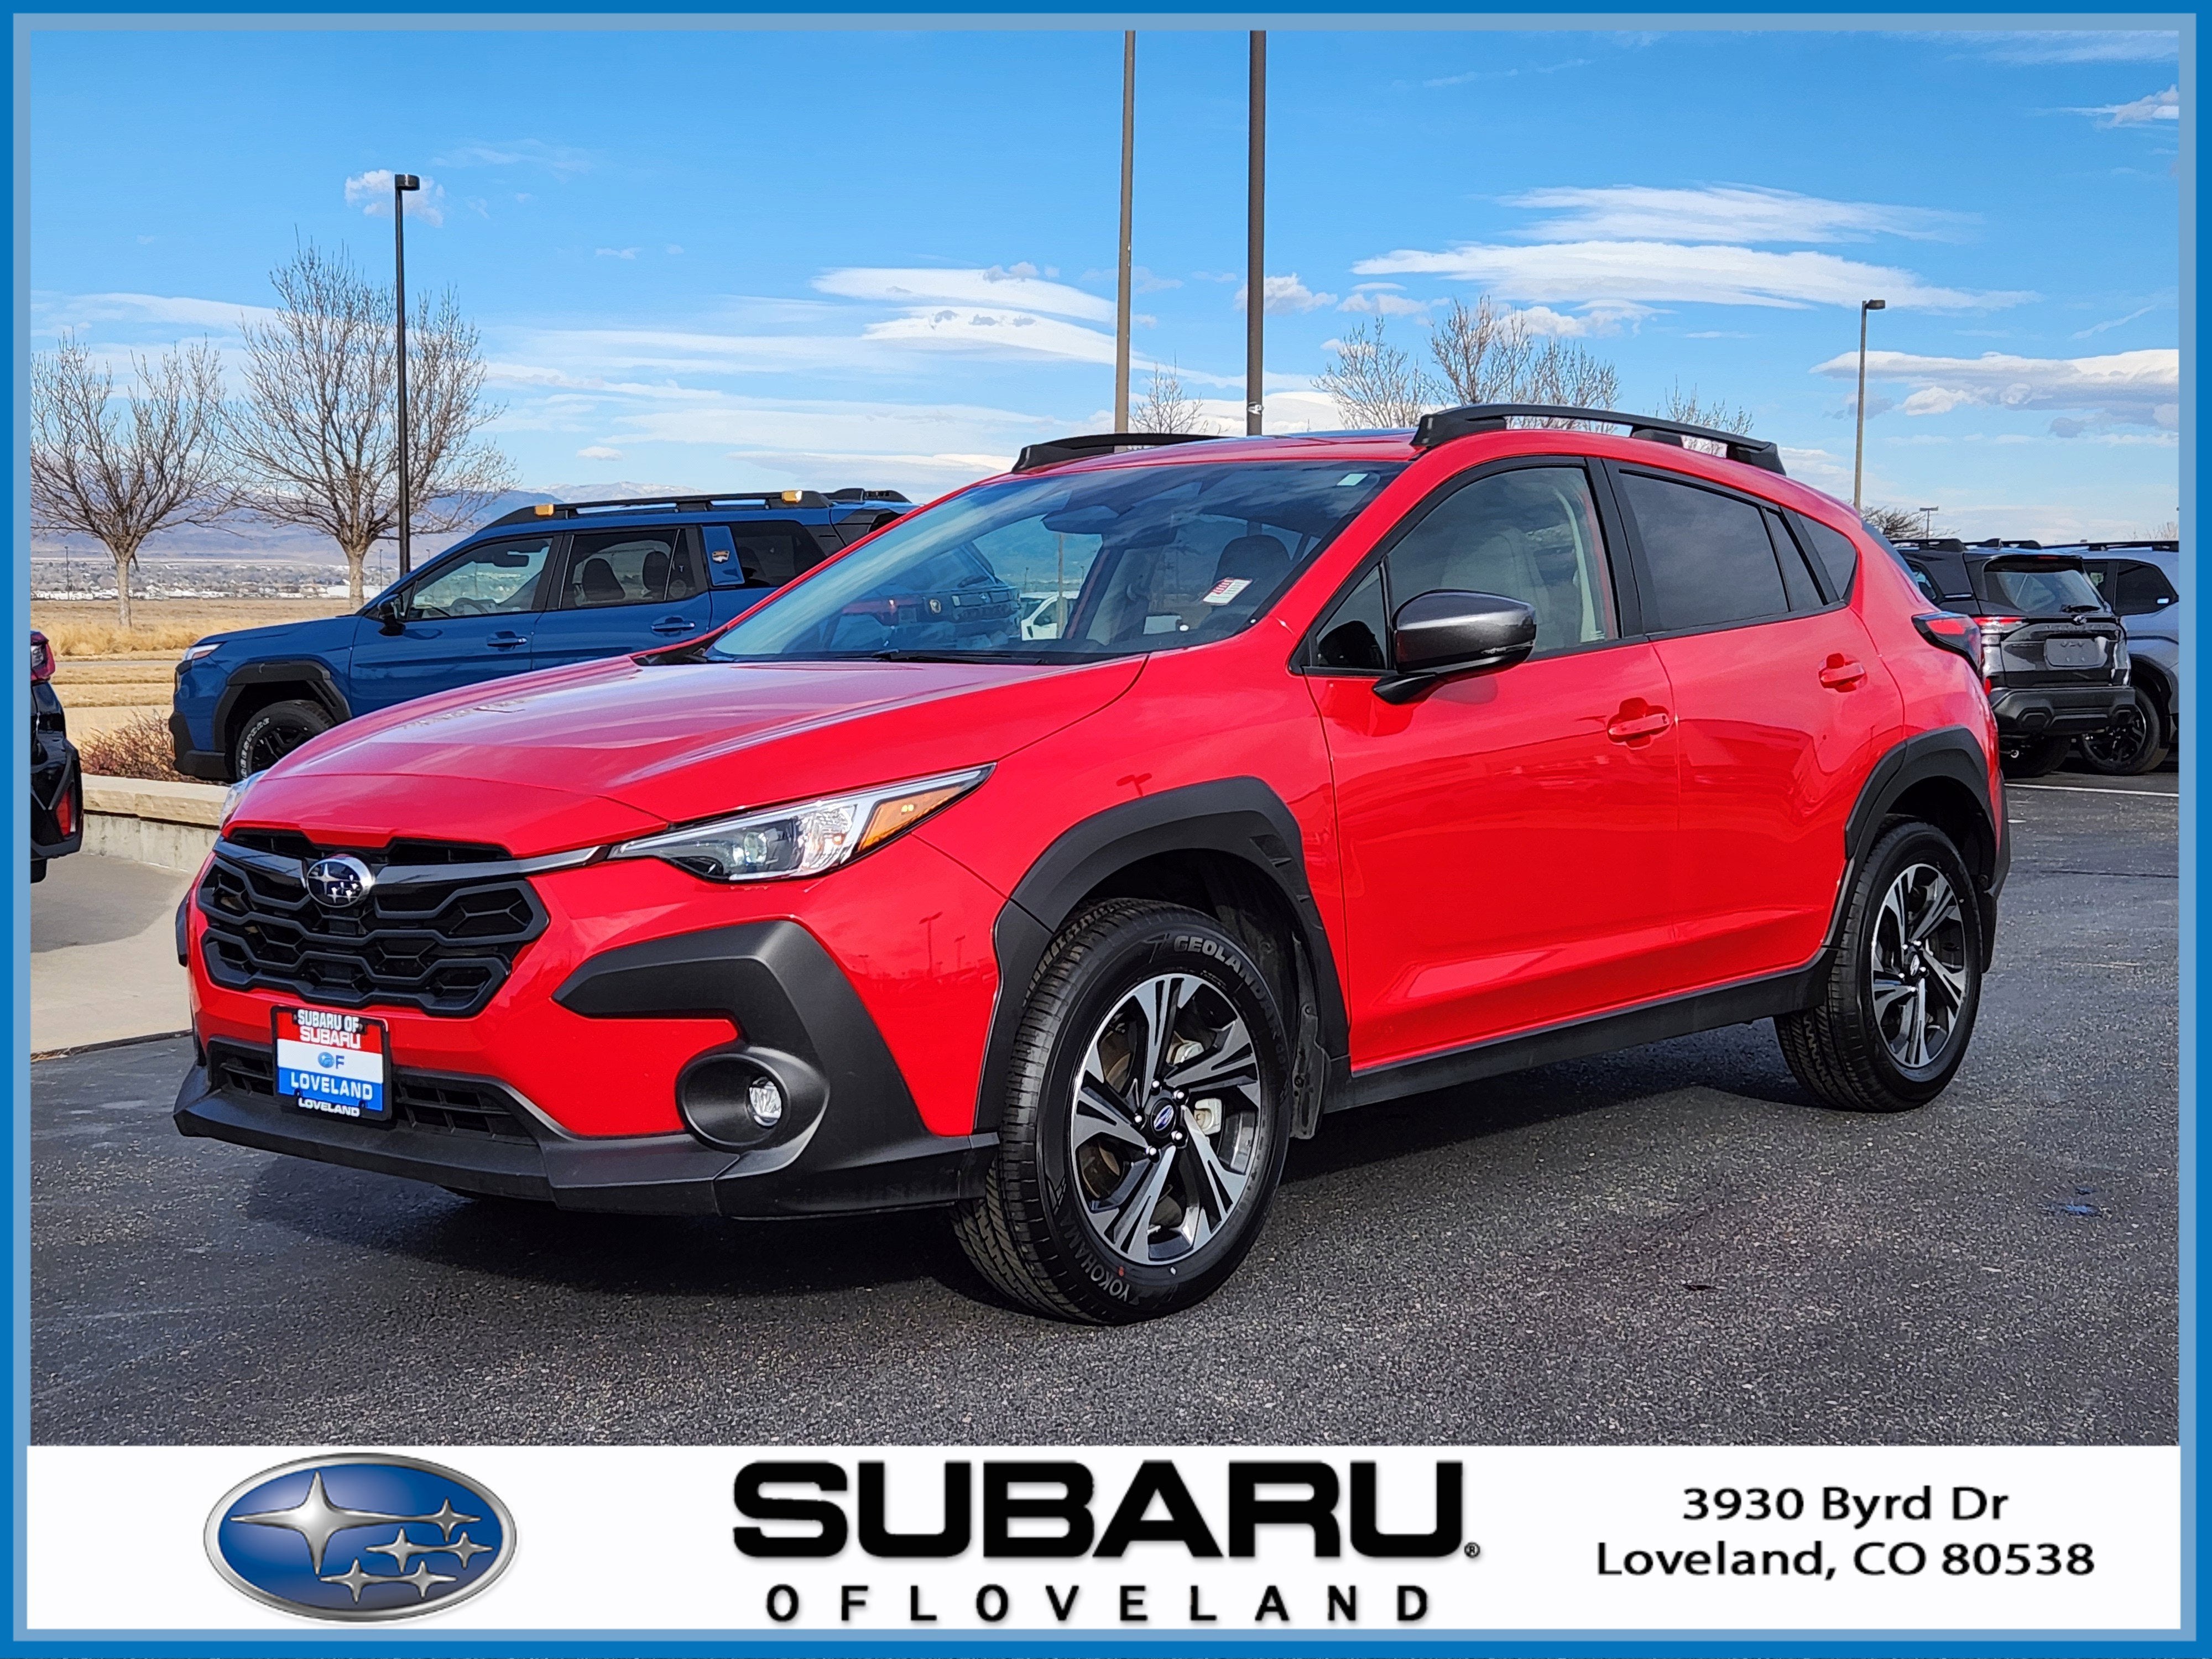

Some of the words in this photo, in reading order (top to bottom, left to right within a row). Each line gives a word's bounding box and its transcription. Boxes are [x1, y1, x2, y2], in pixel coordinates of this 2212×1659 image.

[298, 1009, 342, 1031] SUBARU
[343, 1015, 359, 1033] OF
[299, 1026, 361, 1049] SUBARU
[290, 1072, 373, 1100] LOVELAND
[298, 1097, 360, 1117] LOVELAND
[1060, 1210, 1130, 1302] YOKOHAMA
